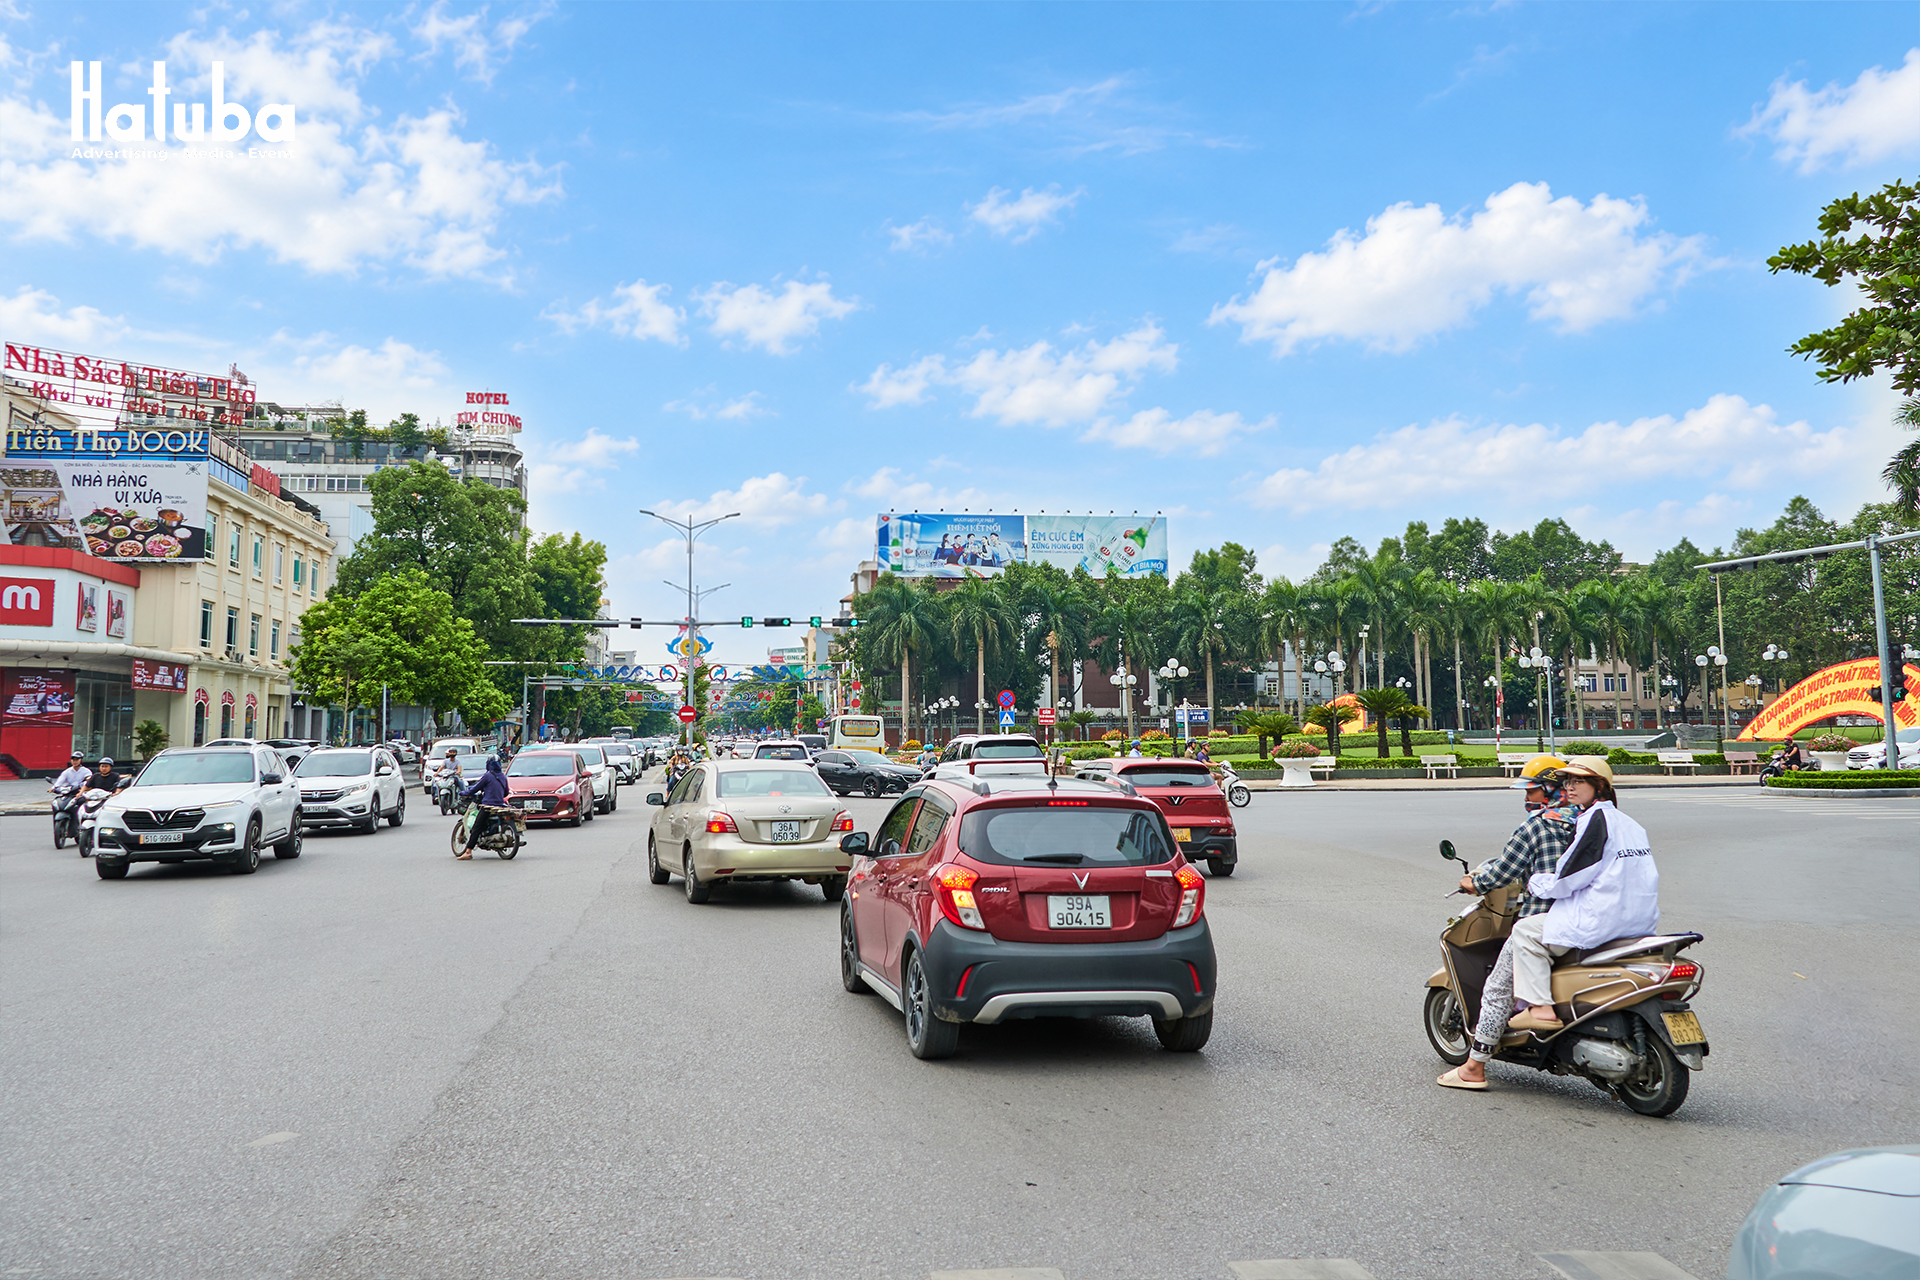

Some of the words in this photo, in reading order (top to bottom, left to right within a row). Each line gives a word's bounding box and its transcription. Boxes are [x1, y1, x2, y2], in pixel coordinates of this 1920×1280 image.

[5, 344, 67, 377] Nhà
[75, 356, 137, 388] Sách
[142, 366, 200, 397] Tiến
[207, 377, 256, 412] Thọ
[33, 381, 70, 402] Khu
[219, 413, 243, 425] em
[466, 392, 509, 405] HOTEL
[457, 411, 478, 424] KIM
[482, 411, 522, 429] CHUNG
[6, 428, 63, 450] Tiến
[70, 429, 122, 458] Thọ
[127, 429, 205, 452] BOOK
[72, 470, 103, 487] NHÀ
[107, 470, 147, 487] HÀNG
[115, 491, 129, 507] VỊ
[133, 489, 162, 504] XƯA
[1031, 529, 1046, 541] ÊM
[1070, 529, 1084, 541] ÊM
[1139, 561, 1150, 570] BIA
[1150, 560, 1164, 571] MỚI
[38, 682, 46, 691] 2
[1765, 700, 1790, 723] DỰNG
[1790, 685, 1807, 707] ĐẤT
[1833, 664, 1859, 684] PHÁT
[1778, 708, 1803, 731] HẠNH
[1804, 692, 1827, 716] PHÚC
[1827, 688, 1860, 706] TRONG
[778, 822, 793, 832] 36A
[773, 832, 799, 841] 050.39
[1066, 897, 1092, 911] 99A
[1057, 913, 1104, 926] 904.15
